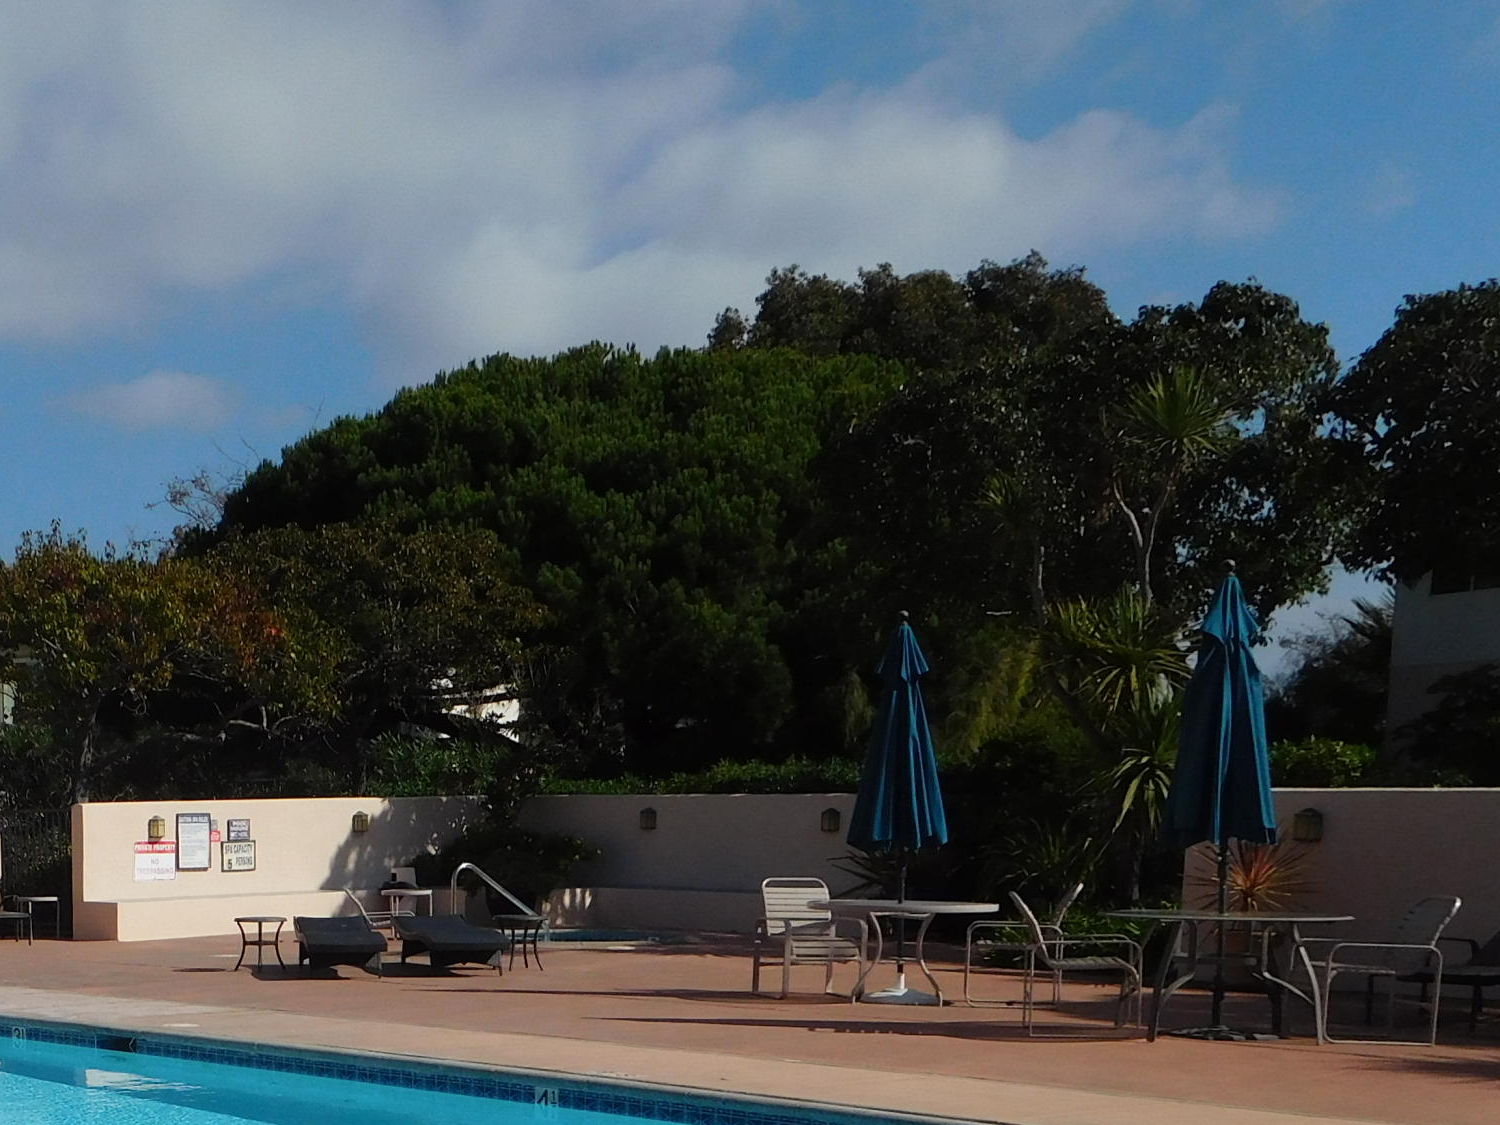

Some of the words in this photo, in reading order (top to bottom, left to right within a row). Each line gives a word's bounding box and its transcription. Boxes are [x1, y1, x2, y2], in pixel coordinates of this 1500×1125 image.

[225, 845, 233, 854] SPA
[233, 844, 253, 854] CAPACITY
[227, 859, 233, 869] 5
[236, 856, 253, 866] PERSONS
